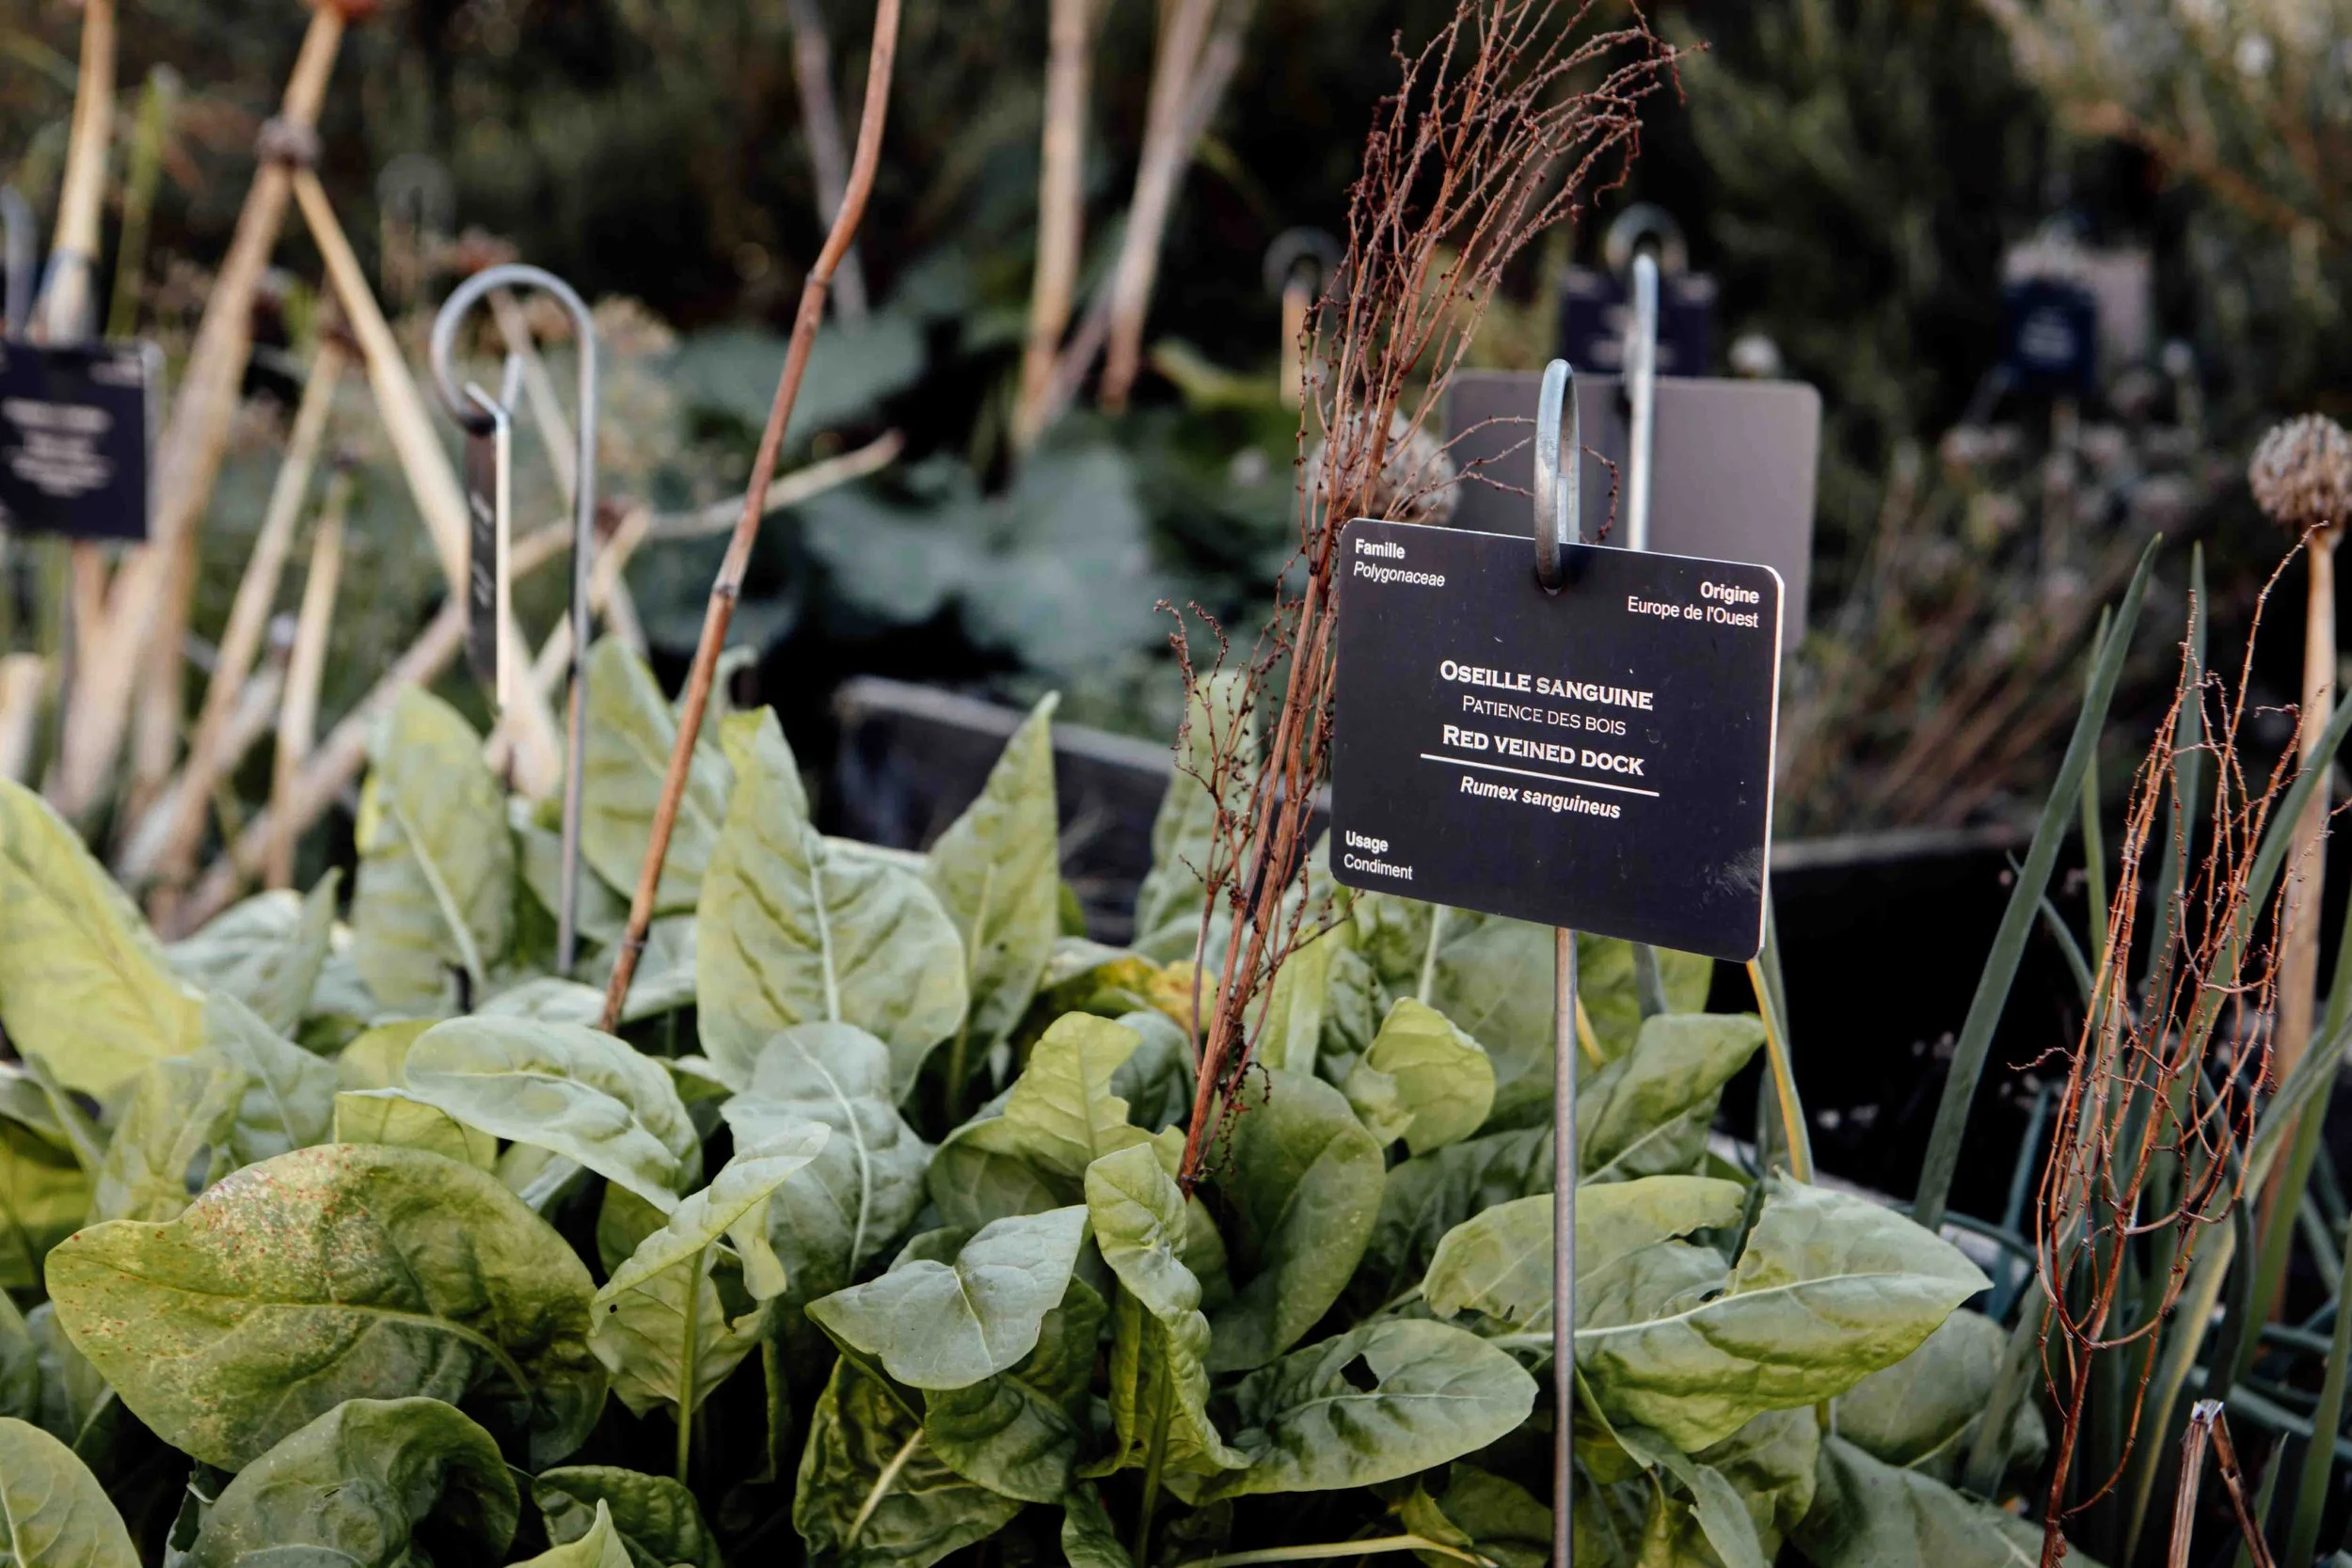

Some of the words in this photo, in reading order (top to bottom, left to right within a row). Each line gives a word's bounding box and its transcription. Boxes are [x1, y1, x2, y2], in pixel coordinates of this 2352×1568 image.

[1356, 538, 1406, 559] Famille
[1354, 561, 1445, 587] Polygonaceae
[1701, 581, 1759, 604] Origine
[1629, 595, 1679, 620] Europe
[1684, 604, 1703, 620] de
[1707, 606, 1758, 627] l'Ouest
[1440, 660, 1531, 692] OSEILLE
[1536, 677, 1653, 711] SANGUINE
[1463, 695, 1543, 722] PATIENCE
[1548, 711, 1581, 728] DES
[1585, 717, 1626, 736] BOIS
[1443, 724, 1488, 750] RED
[1494, 736, 1575, 764] VEINED
[1581, 750, 1645, 776] DOCK
[1460, 776, 1518, 801] Rumex
[1522, 790, 1621, 818] sanguineus
[1346, 831, 1389, 853] Usage
[1344, 853, 1412, 879] Condiment
